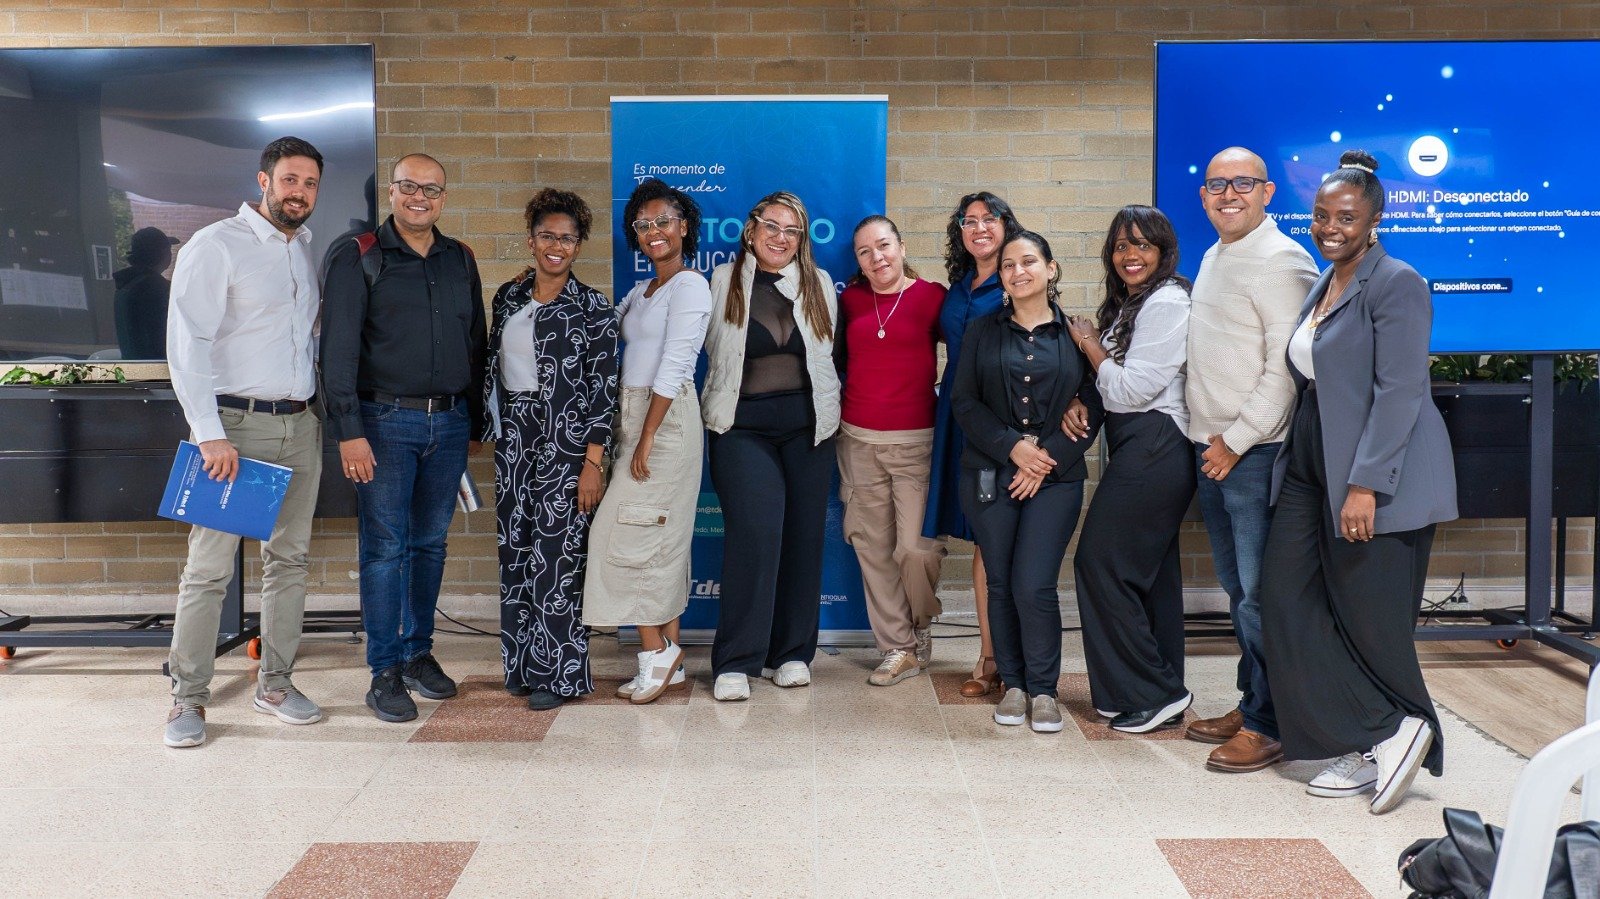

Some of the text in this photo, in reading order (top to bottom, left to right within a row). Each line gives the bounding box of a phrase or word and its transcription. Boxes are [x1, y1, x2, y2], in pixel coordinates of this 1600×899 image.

[633, 163, 726, 175] Es momento de
[1388, 189, 1529, 204] HDMI: Desconectado
[1411, 211, 1426, 219] Para
[1426, 211, 1444, 219] saber
[1445, 210, 1464, 218] cómo
[1464, 211, 1503, 219] conectarlos,
[1544, 209, 1564, 217] botón
[1581, 209, 1590, 217] de
[1290, 226, 1300, 235] (2)
[1391, 225, 1428, 233] conectados
[1428, 225, 1446, 234] abajo
[1507, 225, 1528, 233] origen
[1433, 282, 1508, 293] Dispositivos cone...
